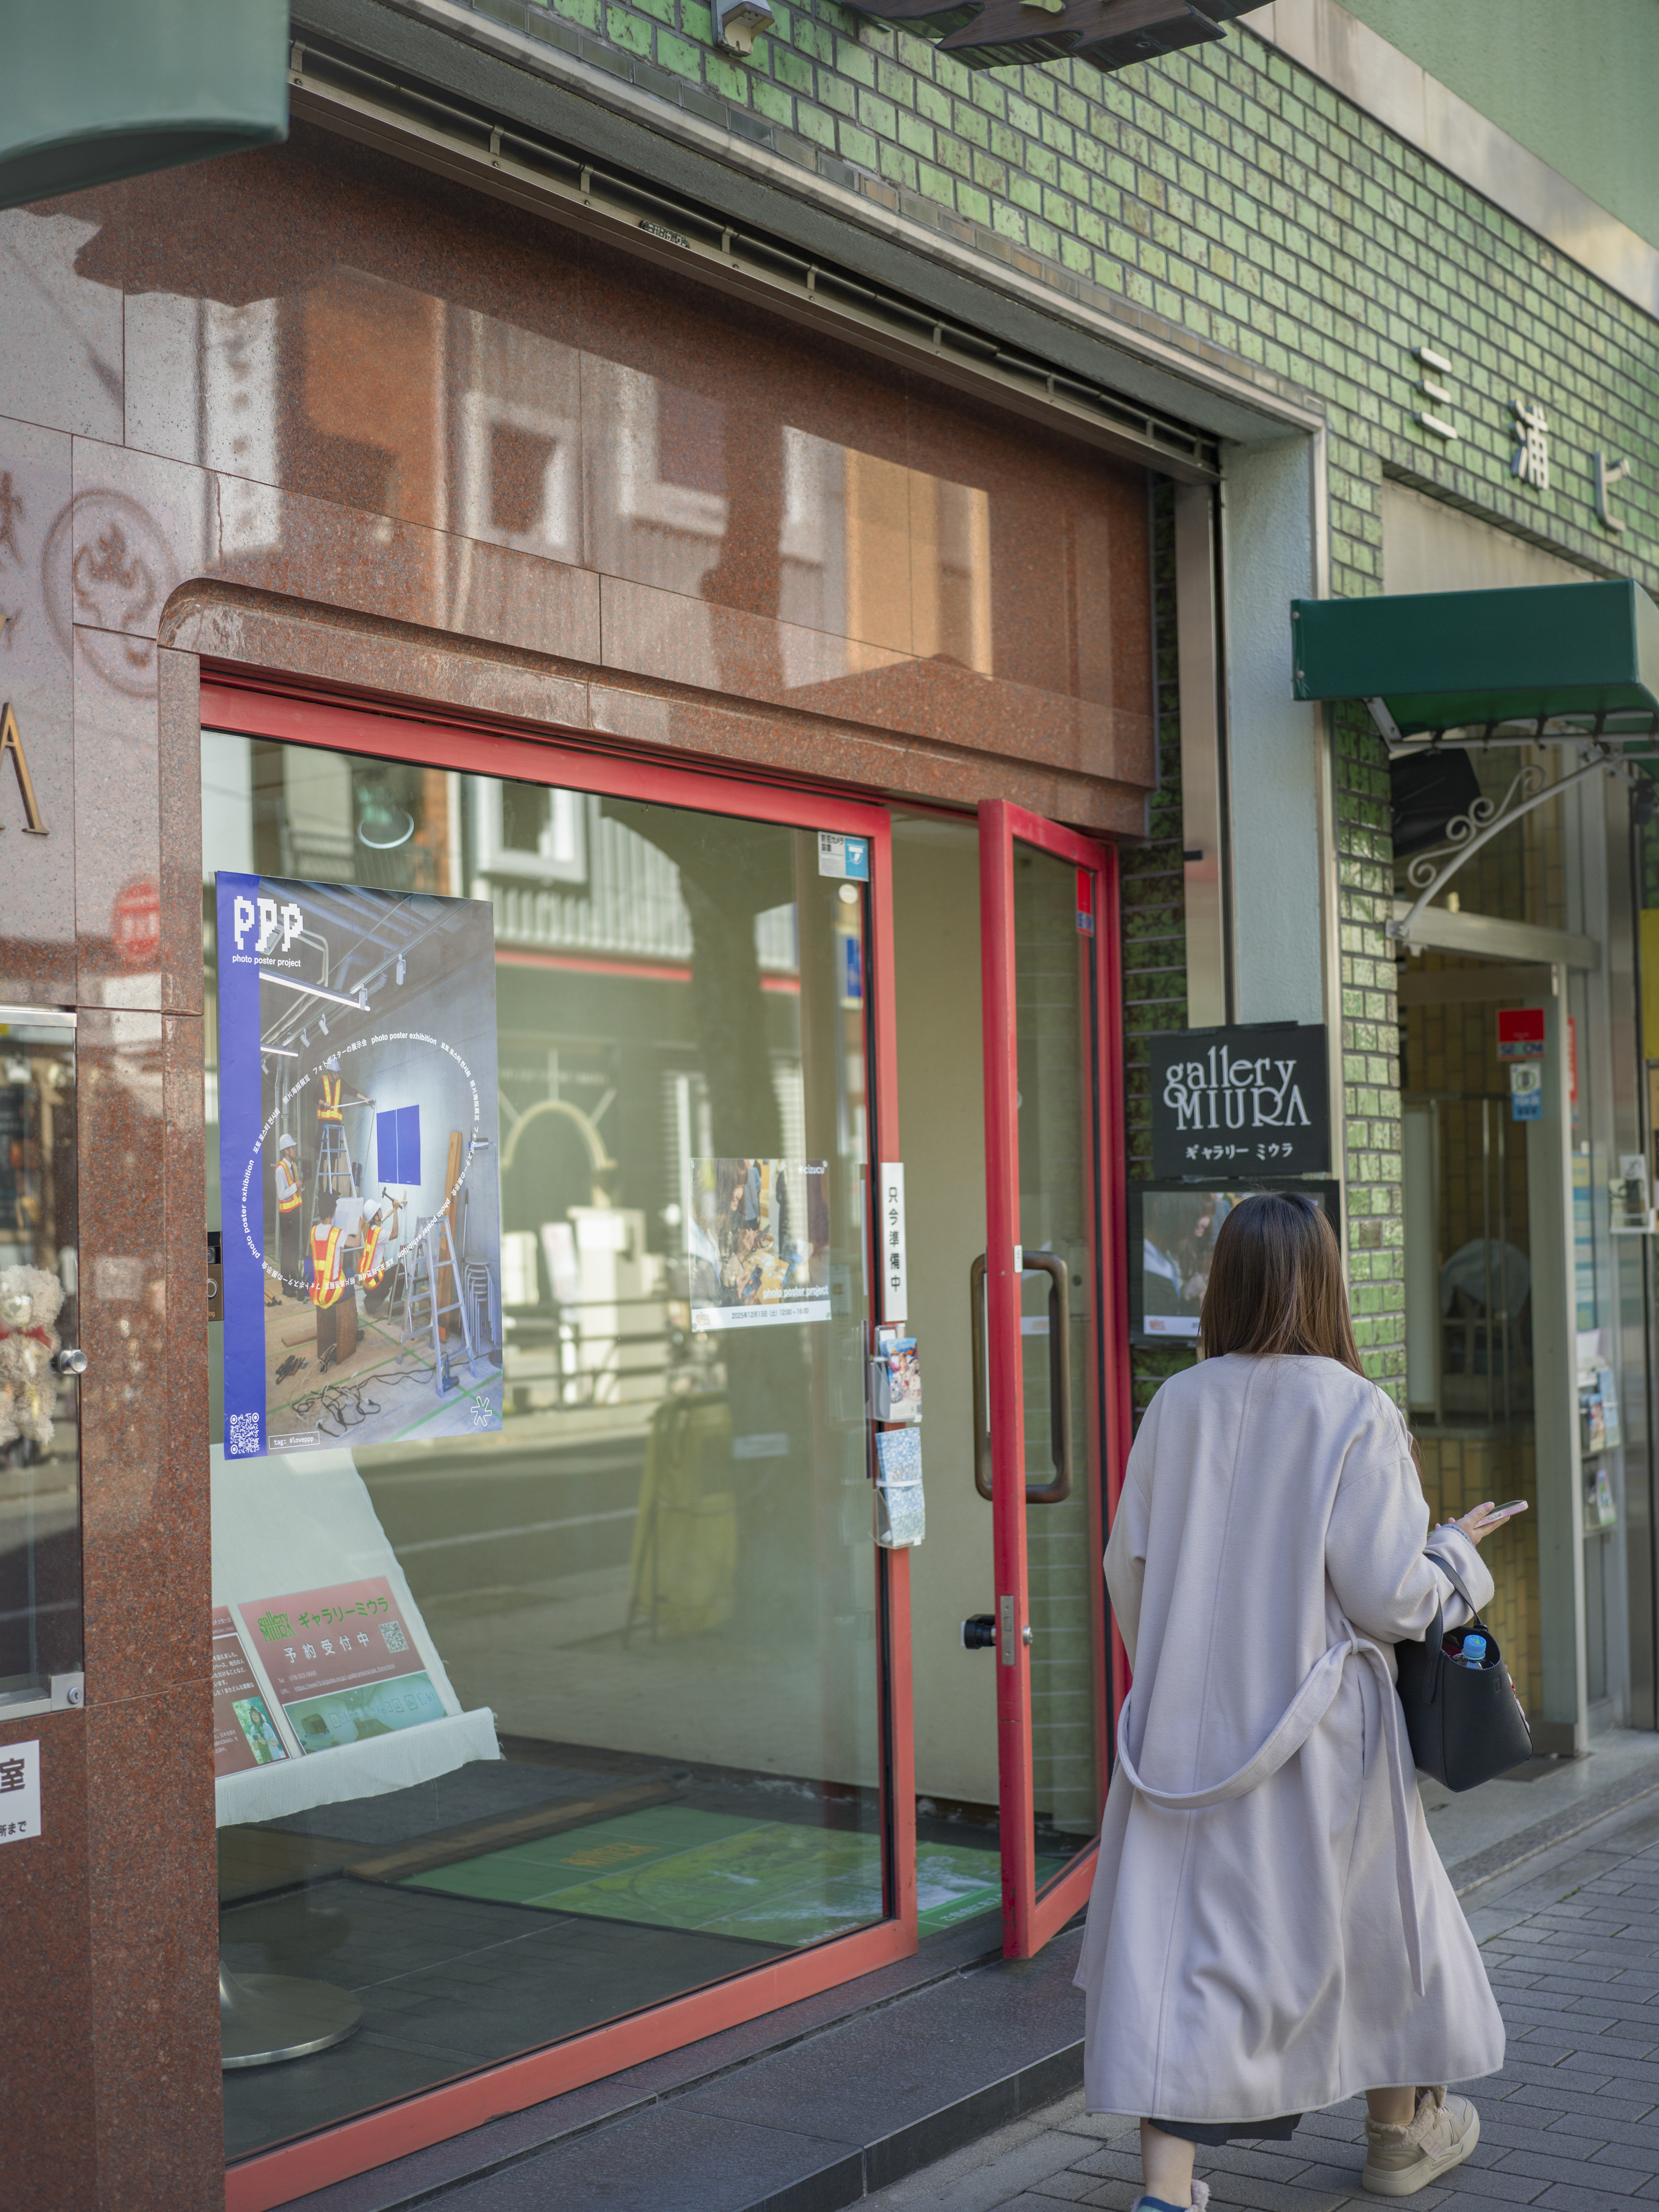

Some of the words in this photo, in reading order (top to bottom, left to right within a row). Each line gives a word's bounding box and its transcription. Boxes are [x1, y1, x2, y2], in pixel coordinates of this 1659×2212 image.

[232, 954, 252, 963] photo
[277, 959, 301, 967] project
[371, 1034, 388, 1044] photo
[389, 1032, 408, 1040] poster
[409, 1032, 437, 1045] exhibition
[312, 1039, 367, 1074] フォトポスターの展示会
[440, 1042, 450, 1052] 포토
[449, 1048, 462, 1063] 포스터
[460, 1060, 471, 1078] 전시회
[1163, 1045, 1297, 1108] gallery
[282, 1074, 311, 1105] 照片海报展览
[1174, 1084, 1311, 1131] MIURA
[253, 1141, 261, 1154] 포토
[259, 1123, 271, 1141] 포스터
[268, 1107, 281, 1125] 전시회
[1185, 1144, 1249, 1160] ギャラリー
[1256, 1143, 1293, 1161] ミウラ
[242, 1160, 254, 1202] exhibition
[437, 1197, 450, 1217] photo
[241, 1205, 251, 1234] poster
[422, 1215, 438, 1236] poster
[247, 1235, 261, 1258] photo
[397, 1234, 422, 1258] exhibition
[888, 1187, 901, 1292] 只今準備中
[763, 1287, 783, 1300] photo
[783, 1287, 805, 1299] poster
[806, 1284, 829, 1297] project
[258, 1611, 288, 1628] gallery
[298, 1597, 389, 1629] ギャラリーミウラ
[260, 1622, 297, 1642] MIURA
[212, 1652, 238, 1662] を迎えました。
[284, 1631, 370, 1663] 予約受付中
[213, 1679, 228, 1687] います。
